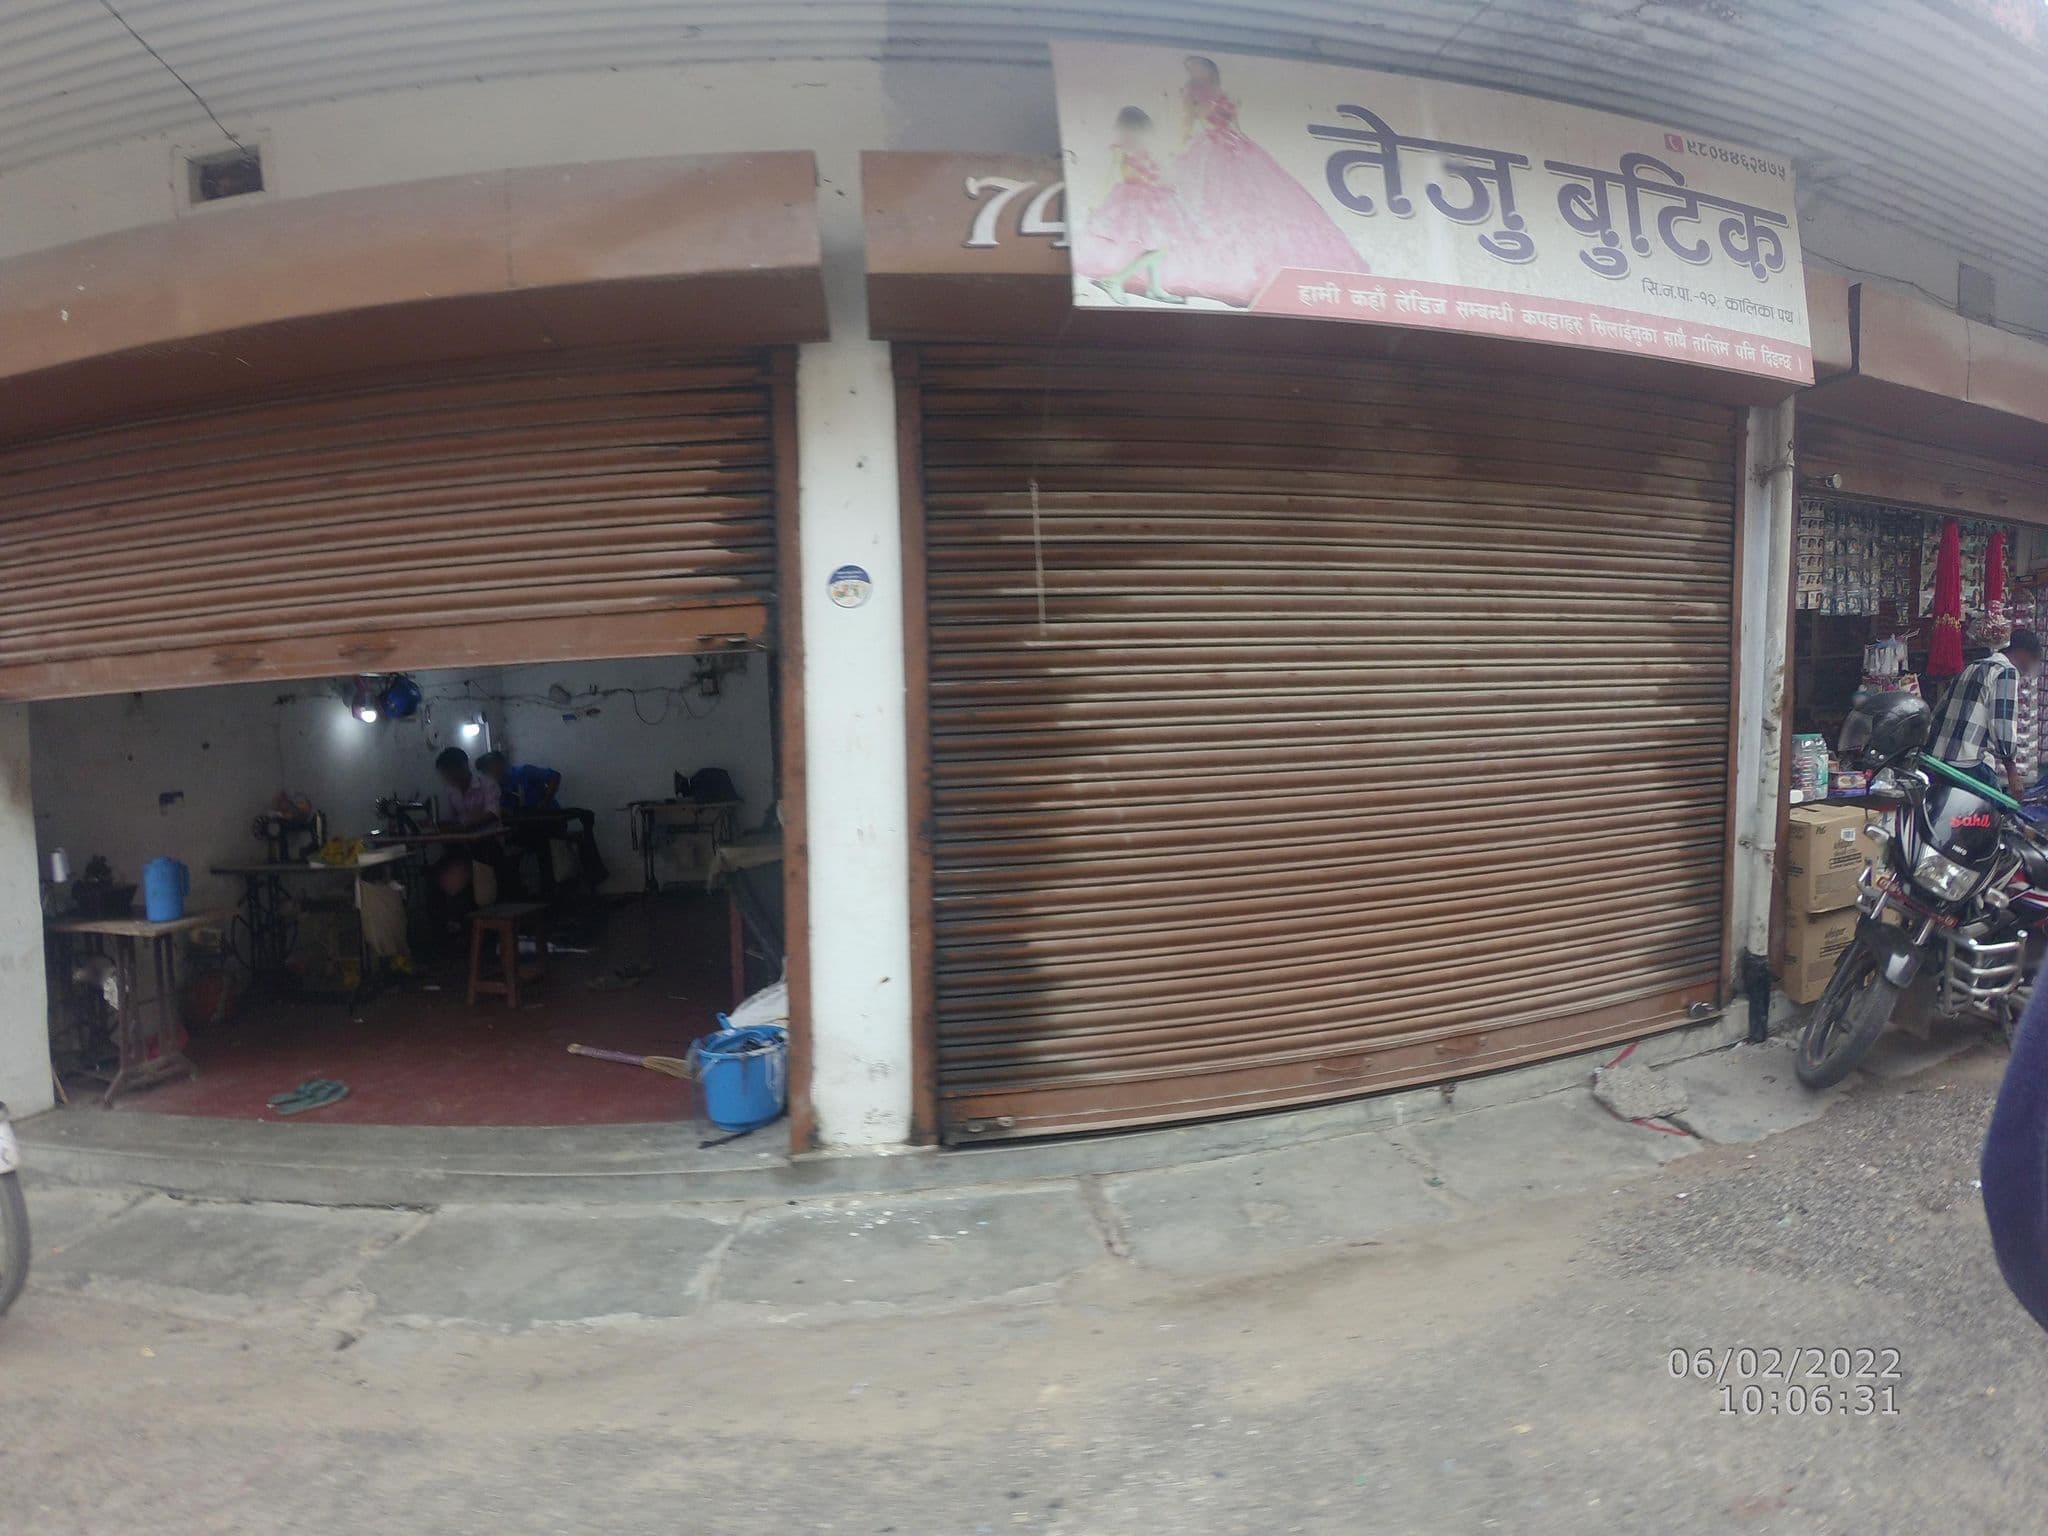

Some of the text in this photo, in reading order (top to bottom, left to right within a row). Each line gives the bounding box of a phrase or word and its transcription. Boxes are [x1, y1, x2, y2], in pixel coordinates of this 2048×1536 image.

[962, 176, 1071, 249] 74
[1306, 103, 1790, 282] तेजु बुटिक
[1297, 281, 1341, 306] हामी
[1348, 286, 1388, 312] कहाँ
[1692, 333, 1730, 357] तालिम
[1733, 341, 1757, 363] पनि
[1724, 296, 1775, 320] कालिका
[1777, 307, 1794, 325] पथ
